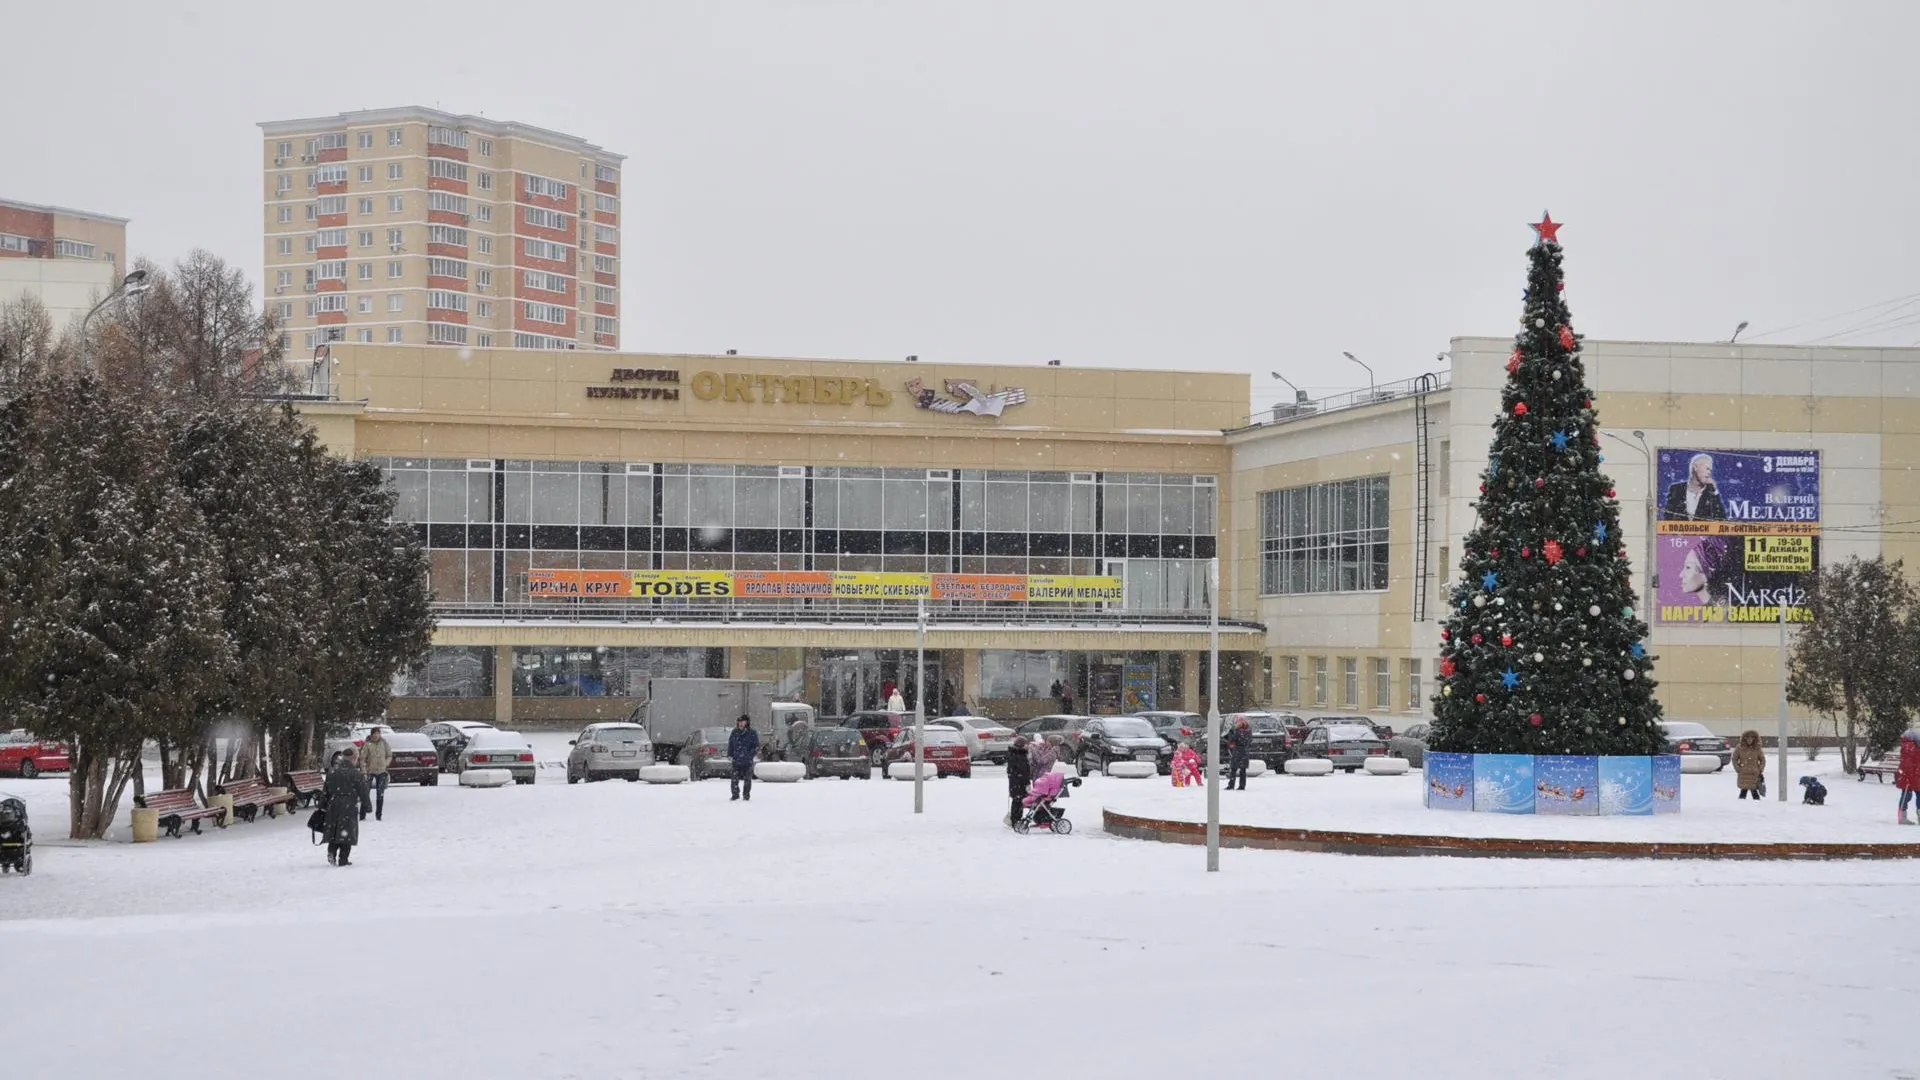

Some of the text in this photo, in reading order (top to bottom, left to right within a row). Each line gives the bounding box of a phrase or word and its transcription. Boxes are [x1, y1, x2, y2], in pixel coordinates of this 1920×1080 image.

[610, 368, 680, 384] ДВОРЕЦ
[586, 386, 680, 400] КУЛЬТУРЫ
[691, 371, 892, 406] ОКТЯБРЬ
[1763, 456, 1772, 473] 3
[1775, 456, 1815, 467] ДЕКАБРЯ
[1728, 499, 1816, 522] МЕЛАДЗЕ
[1668, 524, 1709, 533] ПОДОЛЬСК
[1670, 537, 1689, 548] 16+
[1747, 537, 1767, 553] 11
[1747, 554, 1760, 565] ДК
[530, 581, 621, 594] ИРИНА КРУГ
[635, 581, 730, 596] TODES
[745, 583, 832, 595] ЯРОСЛАВ ЕВДОКИМОВ
[835, 584, 864, 595] НОВЫЕ
[904, 585, 930, 597] БАБКИ
[980, 584, 1026, 593] БЕЗРОДНАЯ
[1029, 587, 1122, 599] ВАЛЕРИЙ МЕЛАДЗЕ
[1661, 606, 1724, 622] НАРГИЗ
